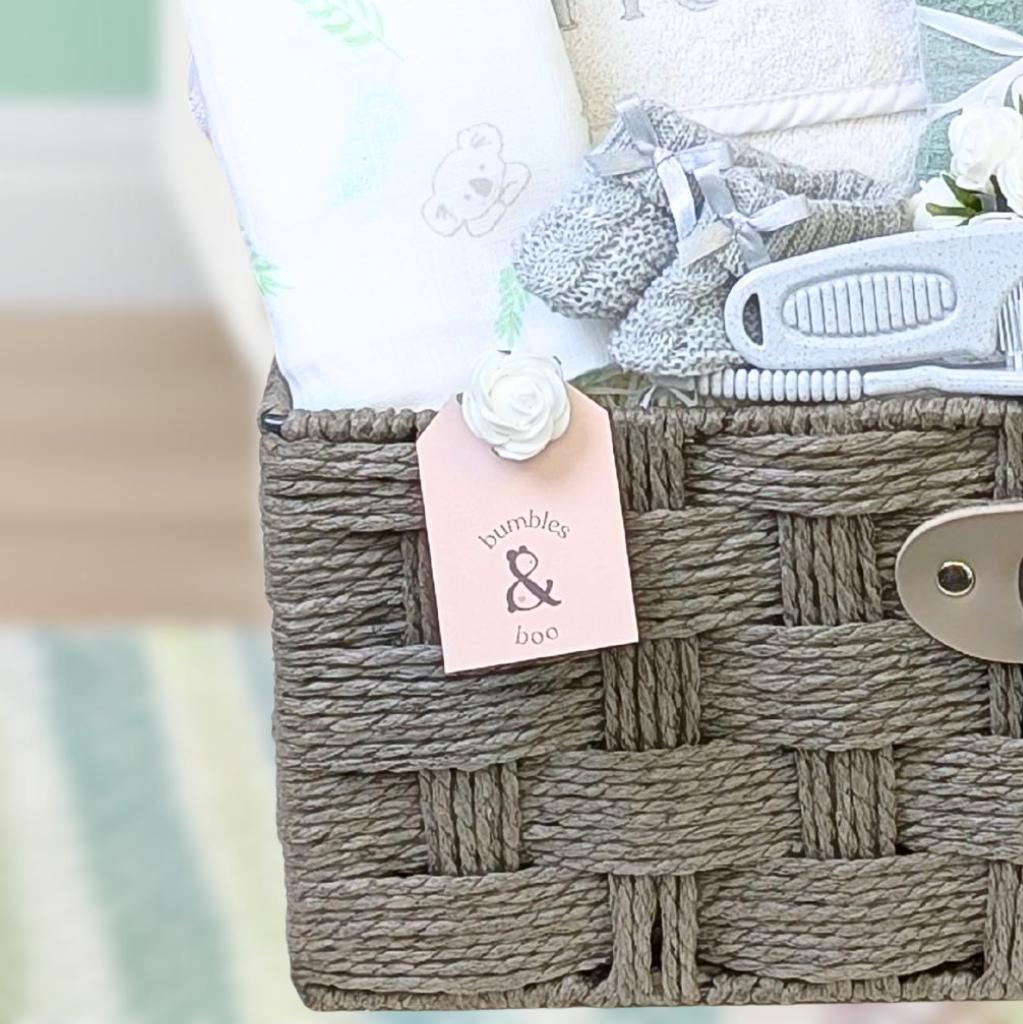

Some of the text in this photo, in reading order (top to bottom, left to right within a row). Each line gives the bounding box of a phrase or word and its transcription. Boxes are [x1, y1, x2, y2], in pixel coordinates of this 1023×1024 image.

[478, 509, 570, 550] bumbles
[506, 545, 562, 613] &
[514, 625, 560, 645] boo
